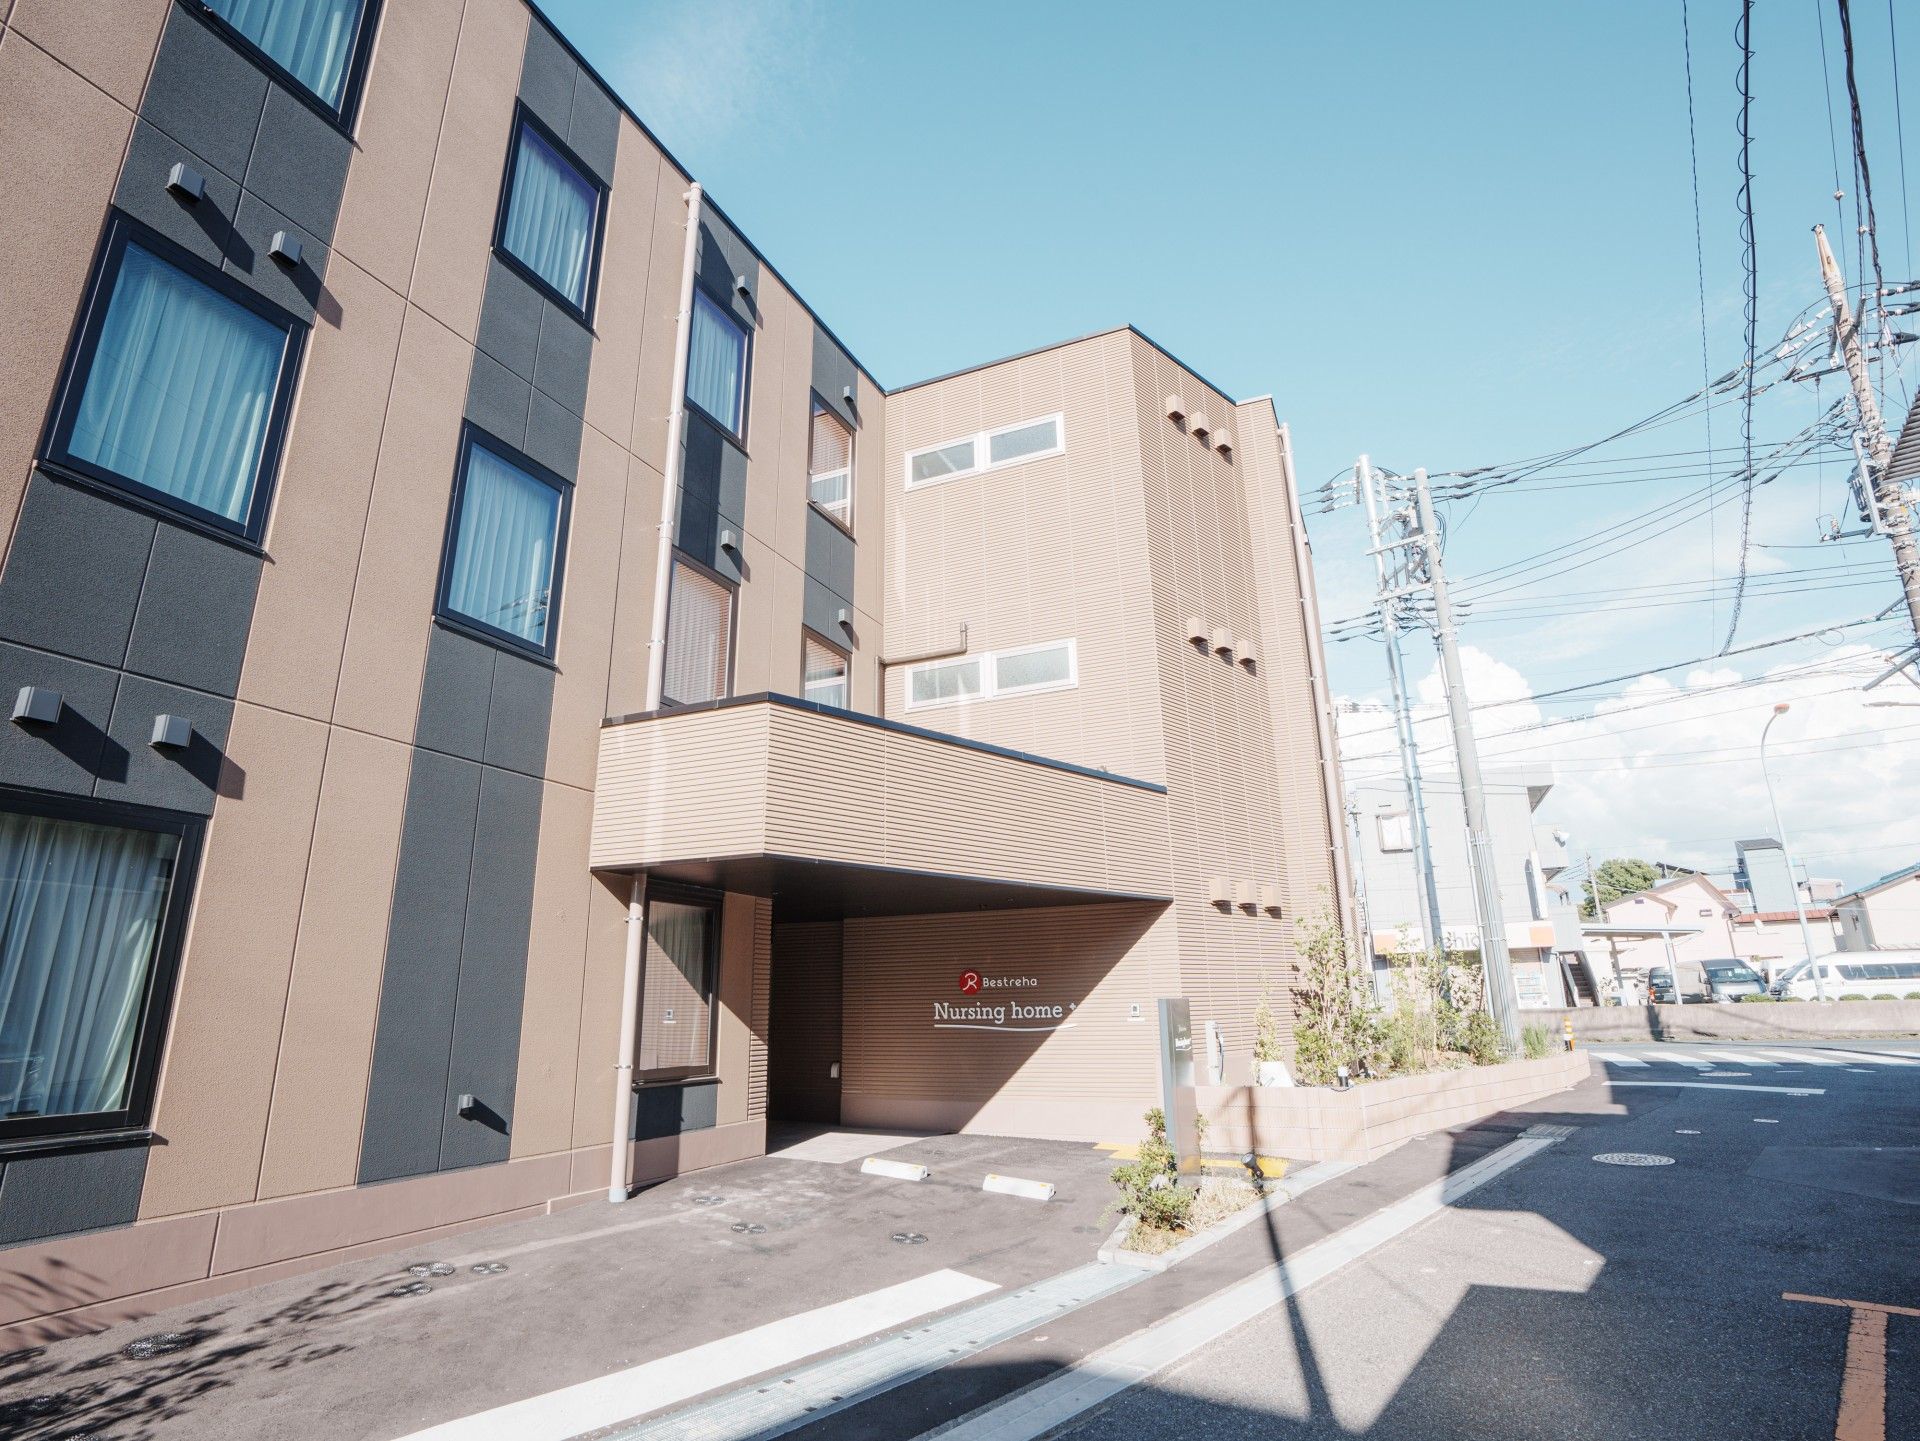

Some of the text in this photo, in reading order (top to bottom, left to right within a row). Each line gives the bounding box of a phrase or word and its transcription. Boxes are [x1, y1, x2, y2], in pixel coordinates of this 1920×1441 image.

[983, 976, 1038, 987] Bestreha
[934, 1001, 1063, 1024] Nursing home
